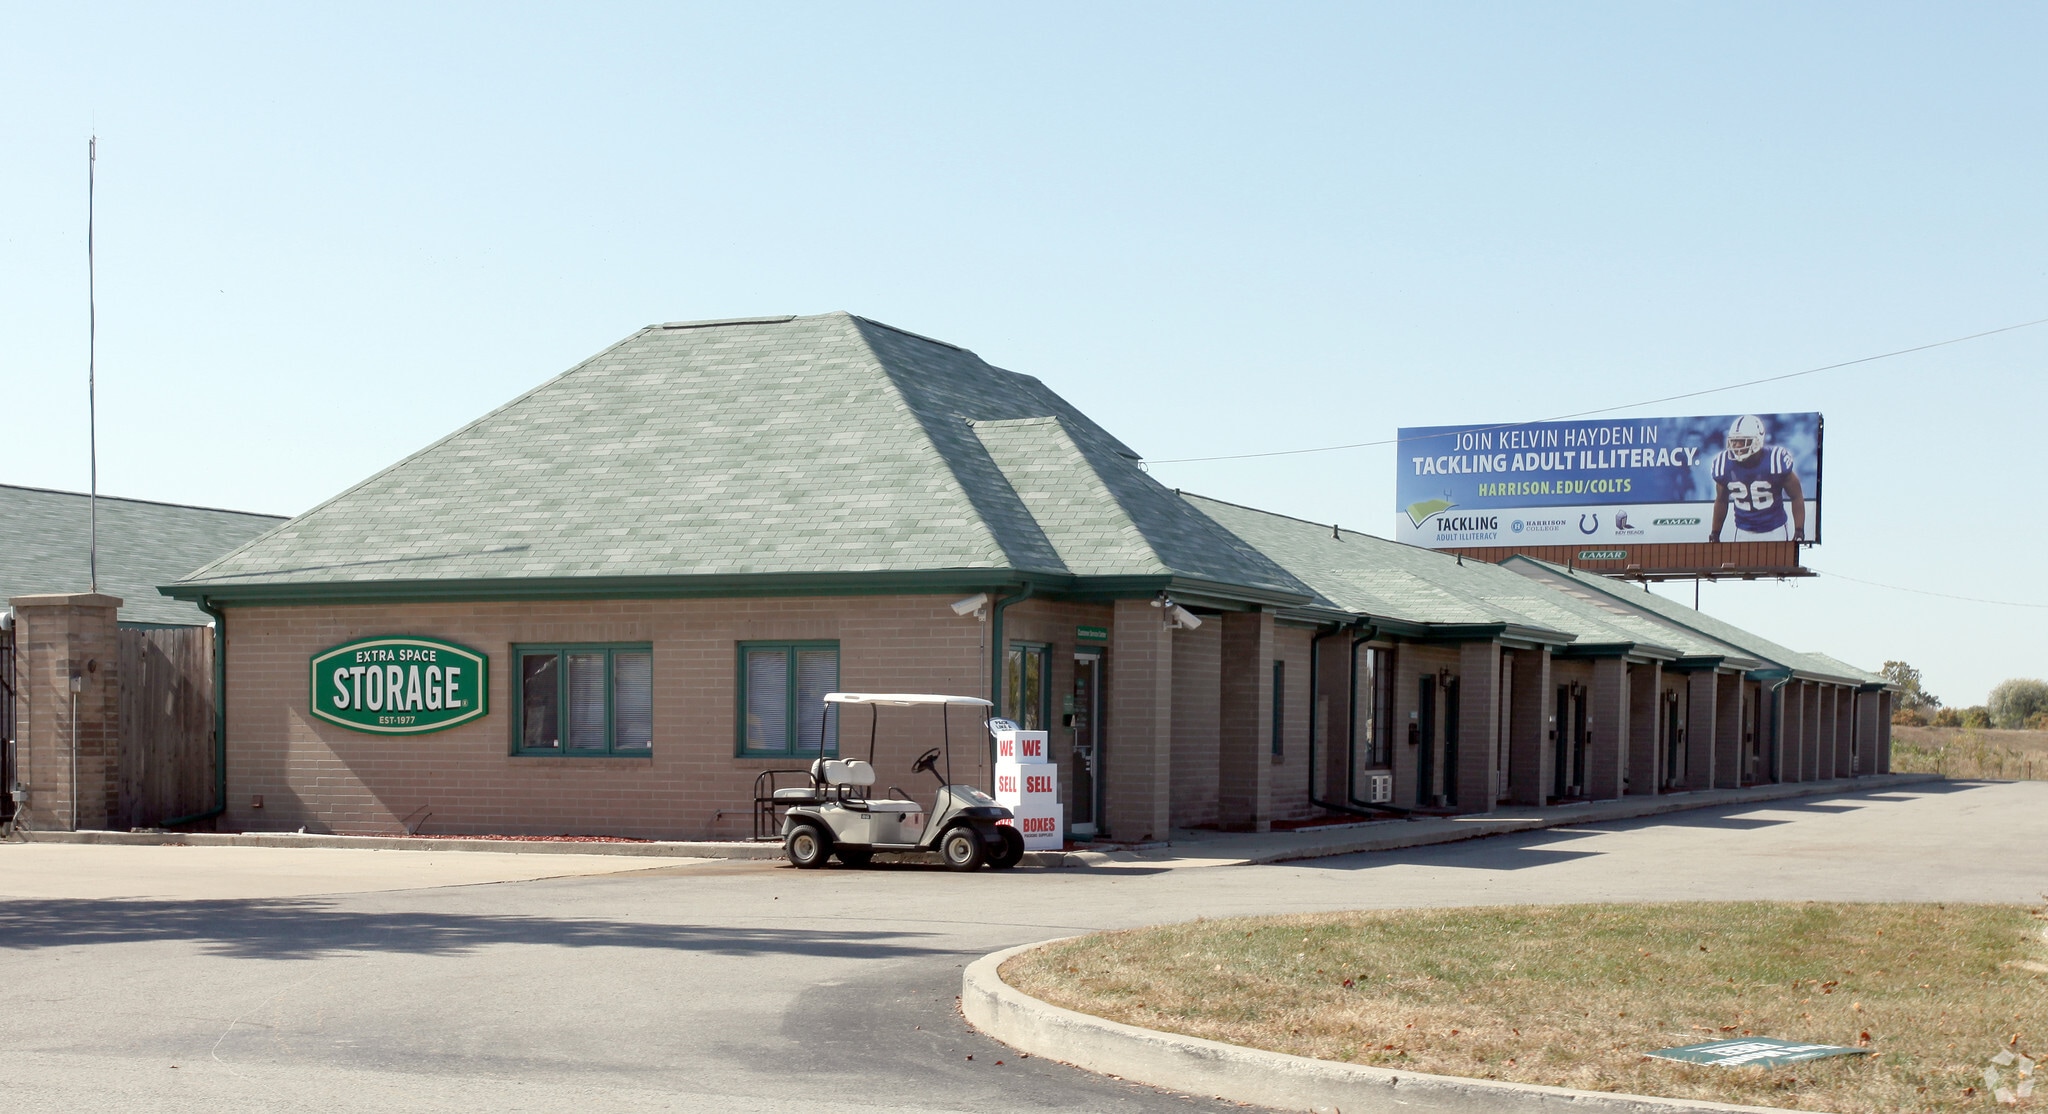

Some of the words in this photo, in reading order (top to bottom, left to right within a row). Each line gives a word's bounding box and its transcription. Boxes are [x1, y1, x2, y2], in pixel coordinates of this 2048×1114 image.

[1453, 433, 1493, 451] JOIN
[1500, 429, 1558, 449] KELVIN
[1564, 427, 1634, 447] HAYDEN
[1640, 426, 1658, 444] IN
[1413, 454, 1507, 476] TACKLING
[1511, 451, 1576, 472] ADULT
[1580, 447, 1701, 469] ILLITERACY.
[1478, 478, 1632, 497] HARRISON.EDU/COLTS
[1727, 480, 1774, 511] 26
[1436, 516, 1498, 531] TACKLING
[1436, 533, 1457, 541] ADULT
[1460, 532, 1498, 540] ILLITERACY
[356, 650, 395, 663] EXTRA
[399, 650, 437, 662] SPACE
[333, 664, 462, 711] STORAGE
[1000, 740, 1013, 757] WE
[1022, 740, 1041, 757] WE
[998, 776, 1017, 793] SELL
[1026, 775, 1053, 793] SELL
[1023, 817, 1055, 832] BOXES
